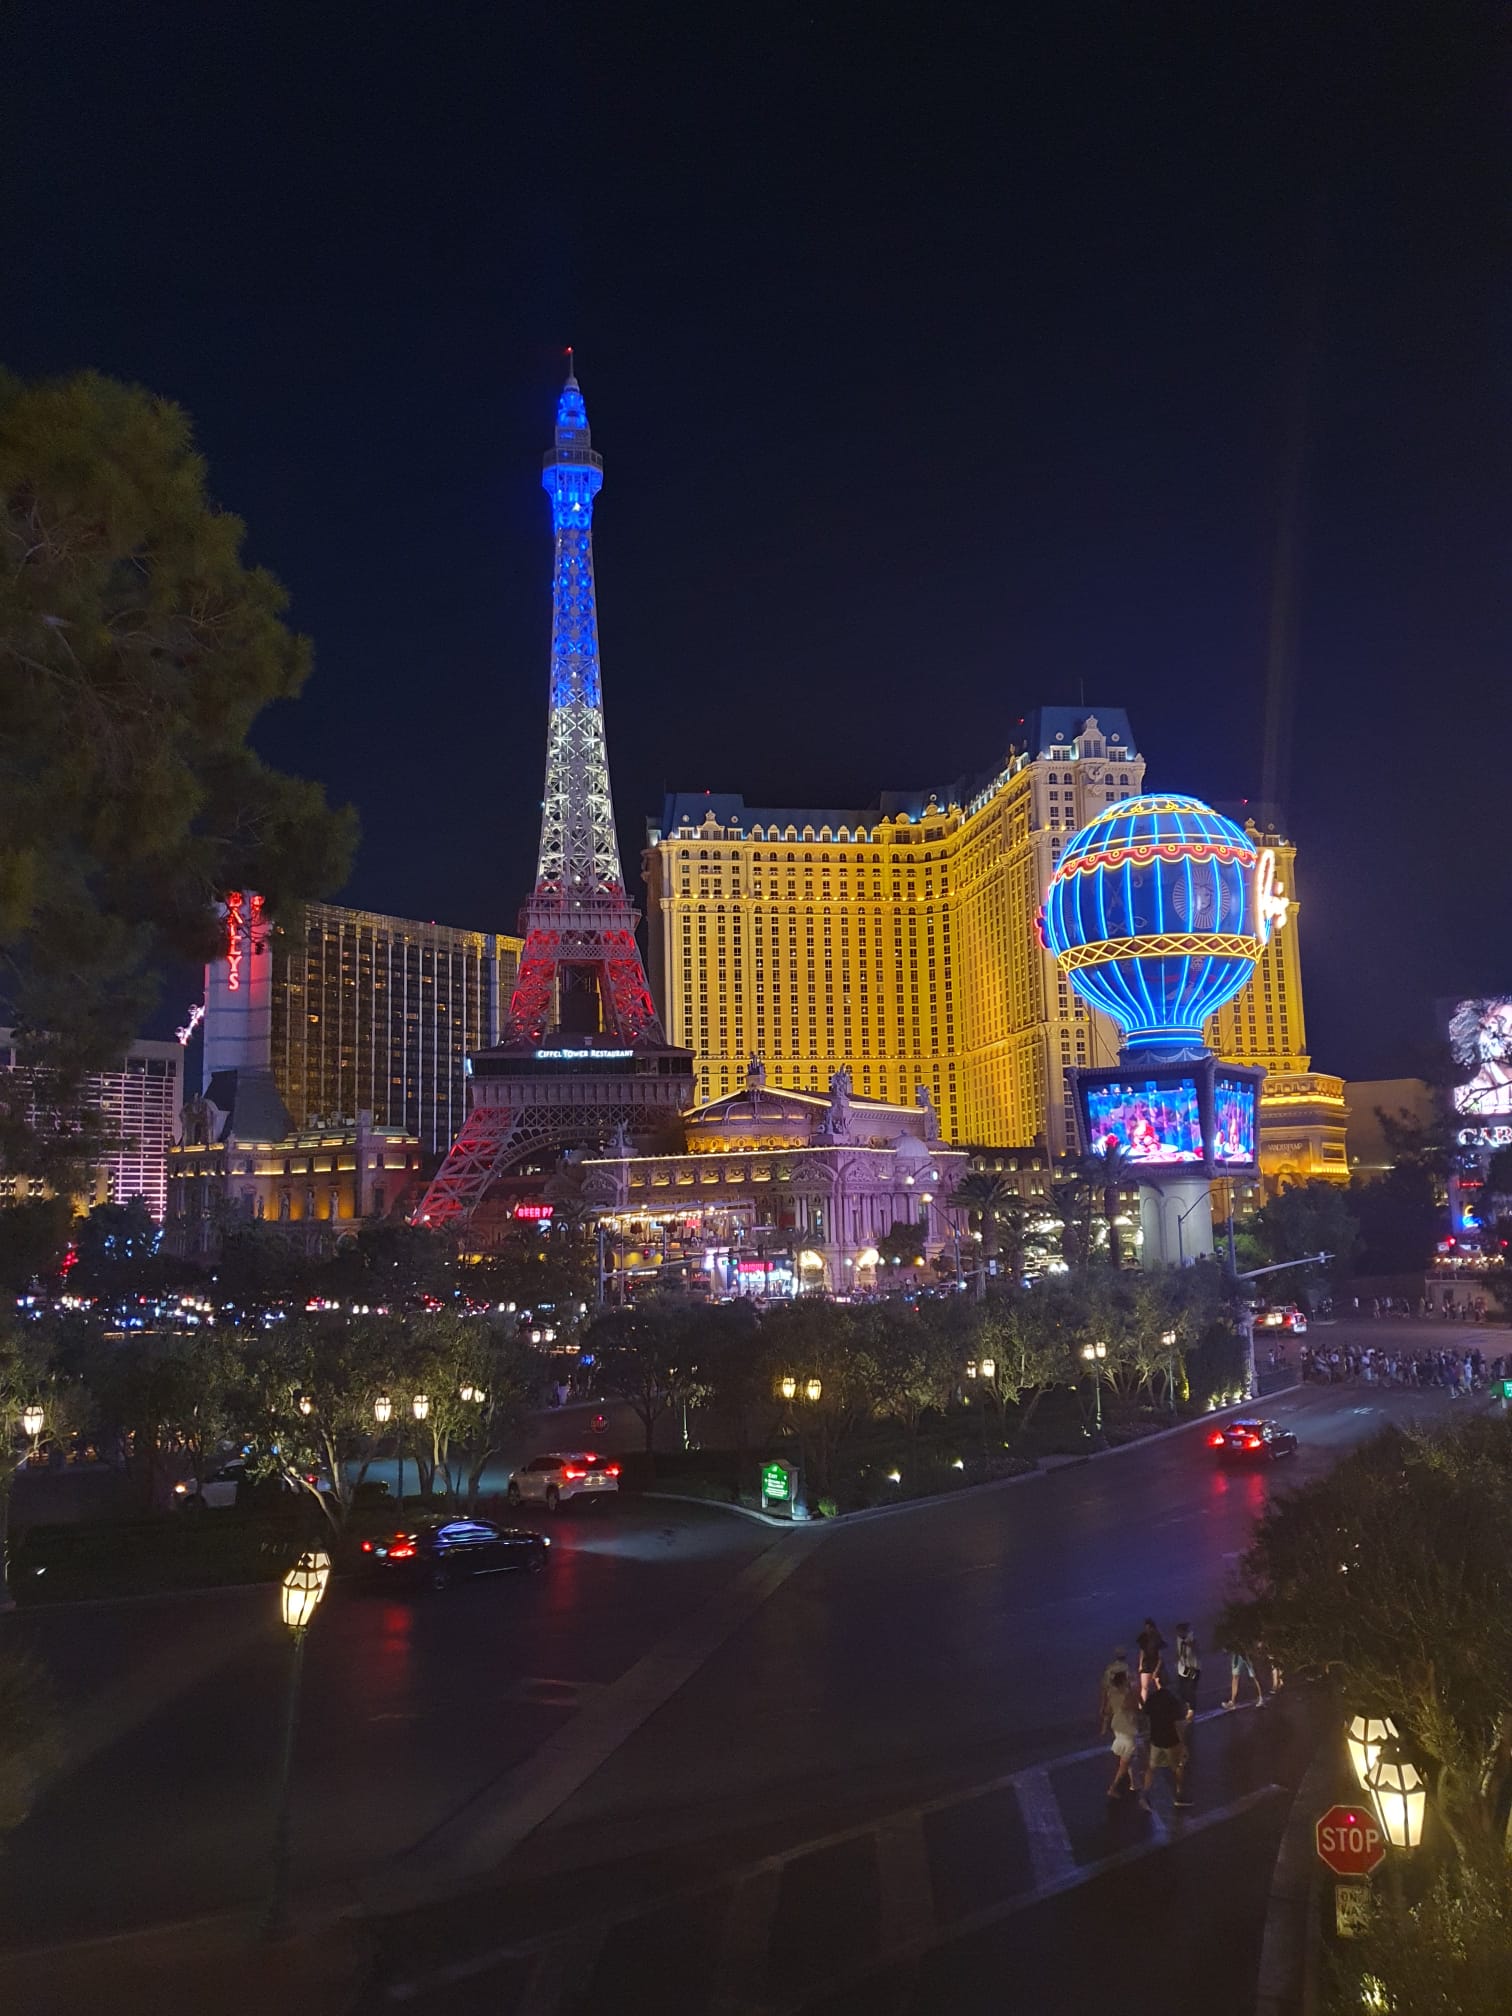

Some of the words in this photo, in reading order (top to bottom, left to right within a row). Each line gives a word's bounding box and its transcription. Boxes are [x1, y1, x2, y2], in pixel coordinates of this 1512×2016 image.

[537, 1049, 562, 1059] EIFFEL
[563, 1048, 588, 1058] TOWER
[590, 1048, 634, 1058] RESTAURANT
[518, 1207, 541, 1218] BEER
[1322, 1827, 1379, 1853] STOP
